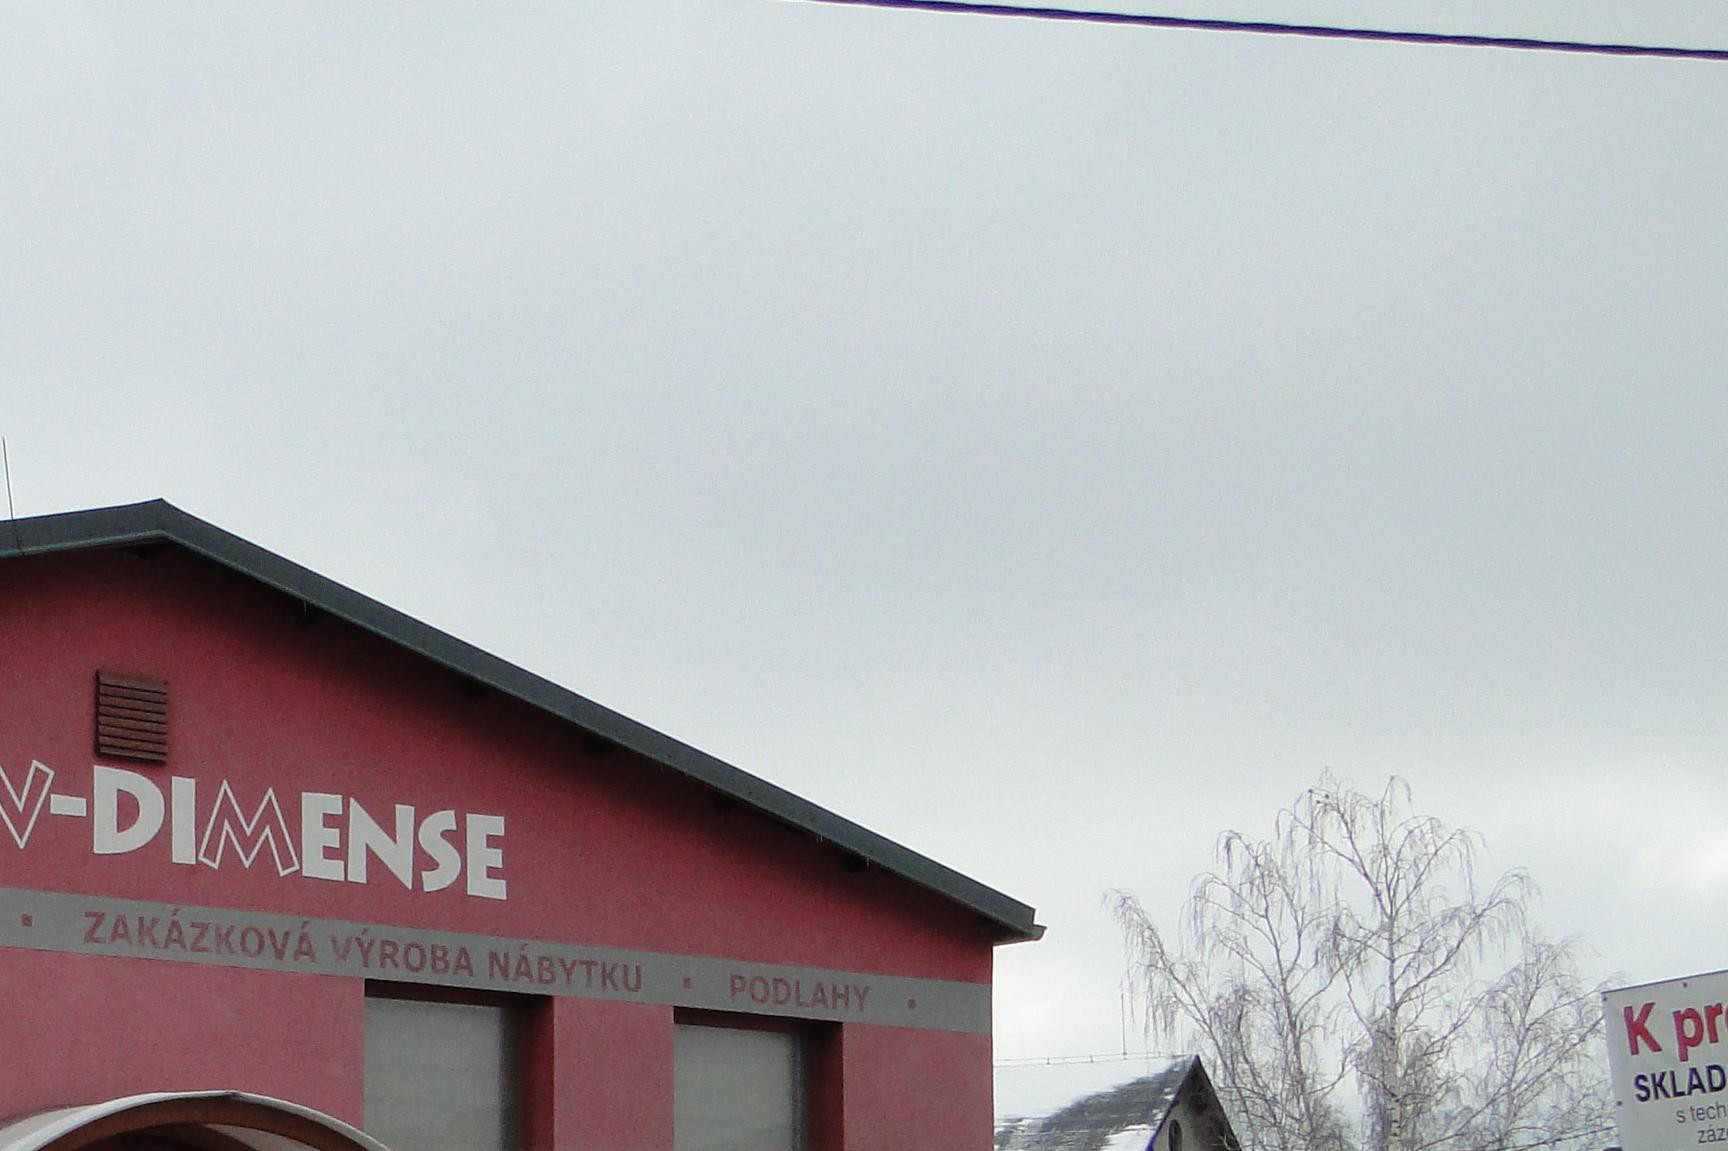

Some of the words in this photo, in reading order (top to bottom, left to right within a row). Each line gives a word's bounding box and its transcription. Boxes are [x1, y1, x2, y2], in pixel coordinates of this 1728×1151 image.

[83, 908, 316, 963] ZAKÁZKOVÁ
[331, 928, 474, 977] VÝROBA
[488, 944, 642, 993] NÁBYTKU
[730, 974, 870, 1012] PODLAHY
[1623, 1002, 1663, 1056] K
[1673, 1003, 1728, 1062] pr
[1676, 1110, 1686, 1123] s
[1698, 1124, 1728, 1144] záz
